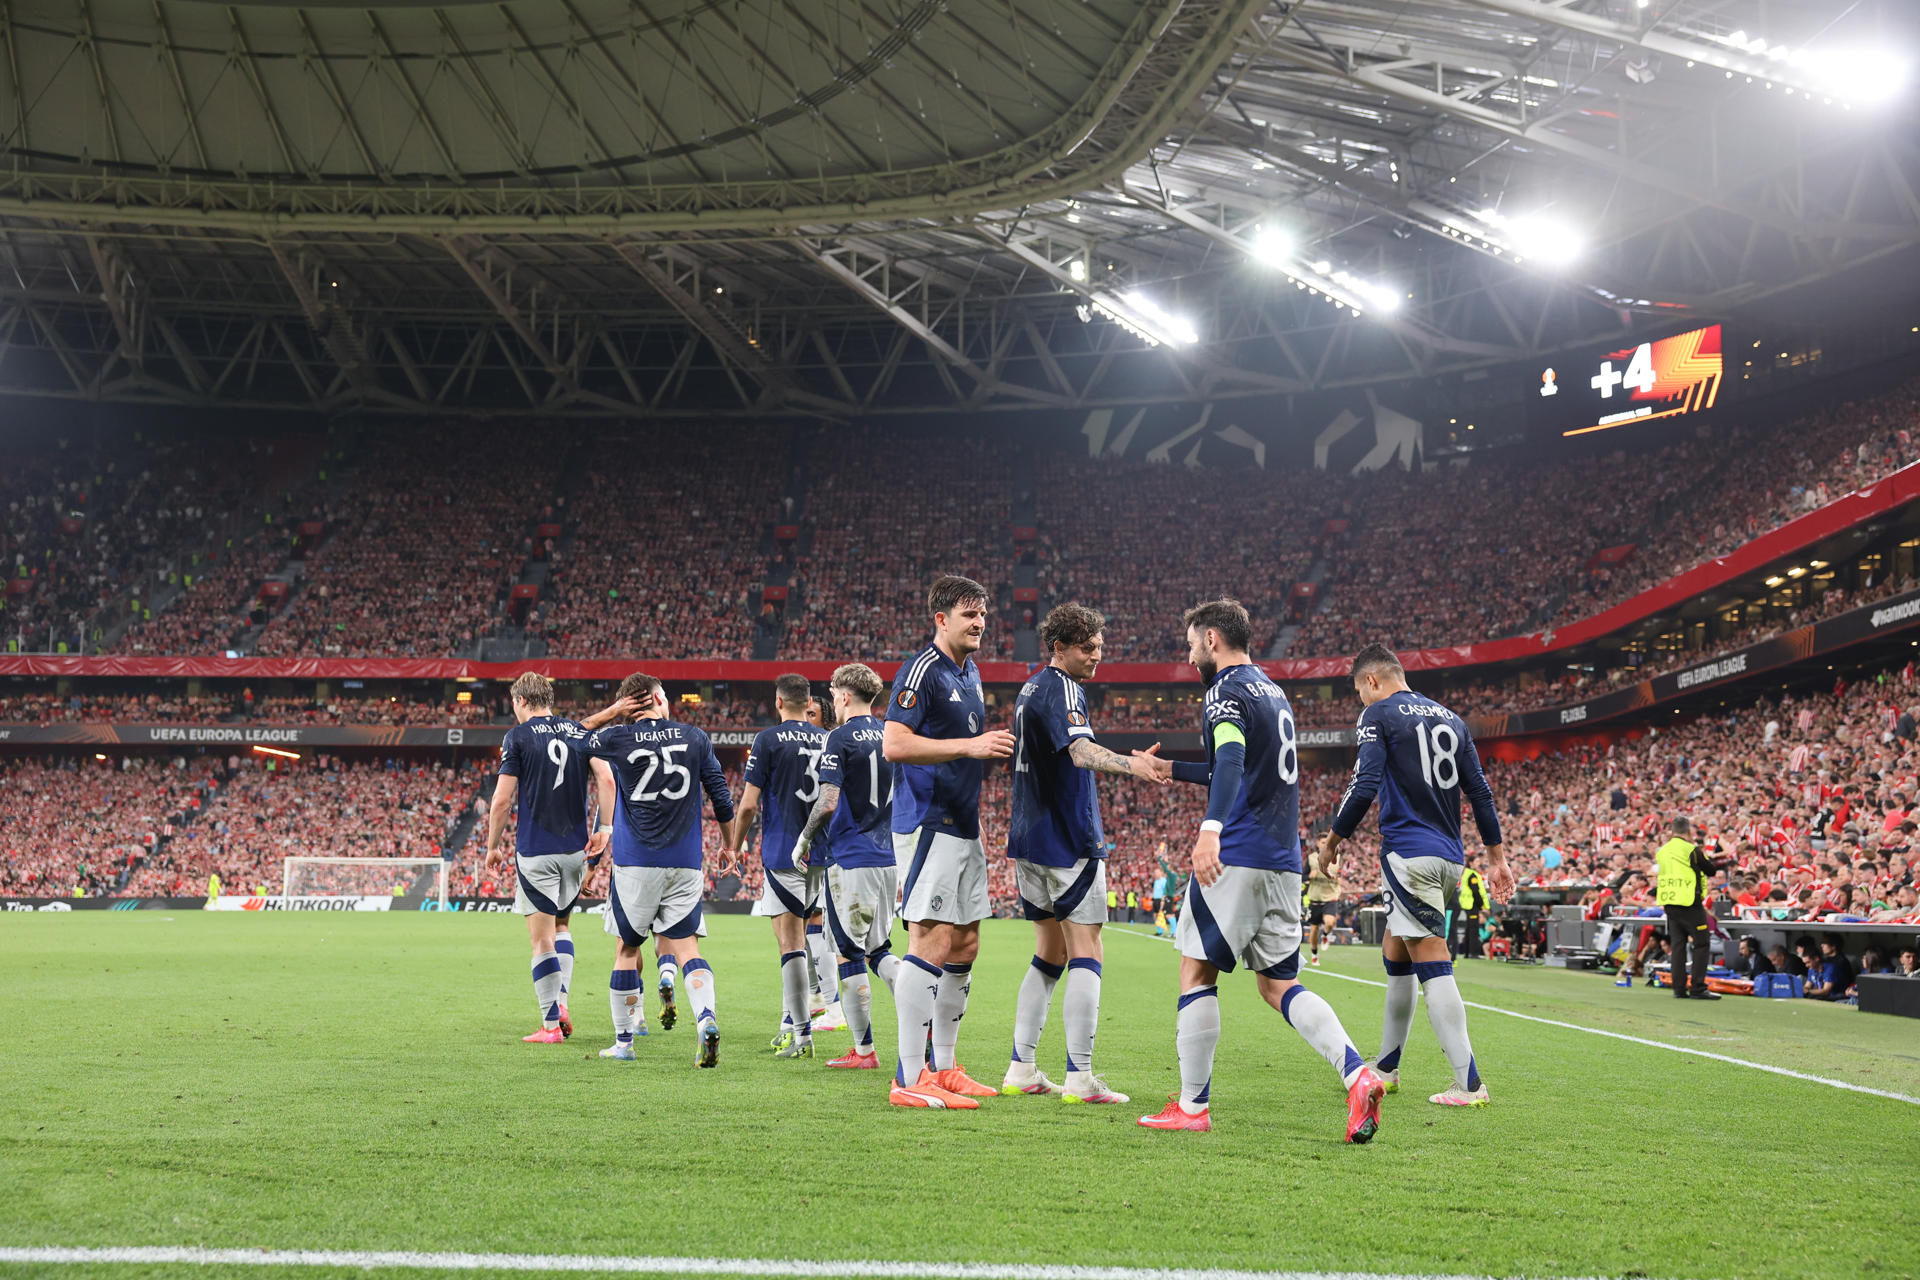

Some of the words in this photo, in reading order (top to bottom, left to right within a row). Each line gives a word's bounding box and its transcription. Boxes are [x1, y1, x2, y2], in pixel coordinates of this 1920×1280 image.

[1591, 343, 1656, 399] +4
[1677, 671, 1694, 689] UEFA
[1694, 663, 1720, 684] EUROPA
[1720, 654, 1747, 676] LEAGUE
[150, 728, 187, 741] UEFA
[189, 728, 243, 741] EUROPA
[245, 729, 298, 742] LEAGUE
[635, 728, 682, 743] UGARTE
[710, 732, 754, 745] EAGUE
[1399, 704, 1453, 720] CASEMIRO
[547, 738, 569, 791] 9
[627, 743, 691, 801] 25
[1278, 709, 1298, 785] 8
[1416, 721, 1459, 789] 18
[795, 746, 822, 803] 3
[868, 749, 896, 809] 1
